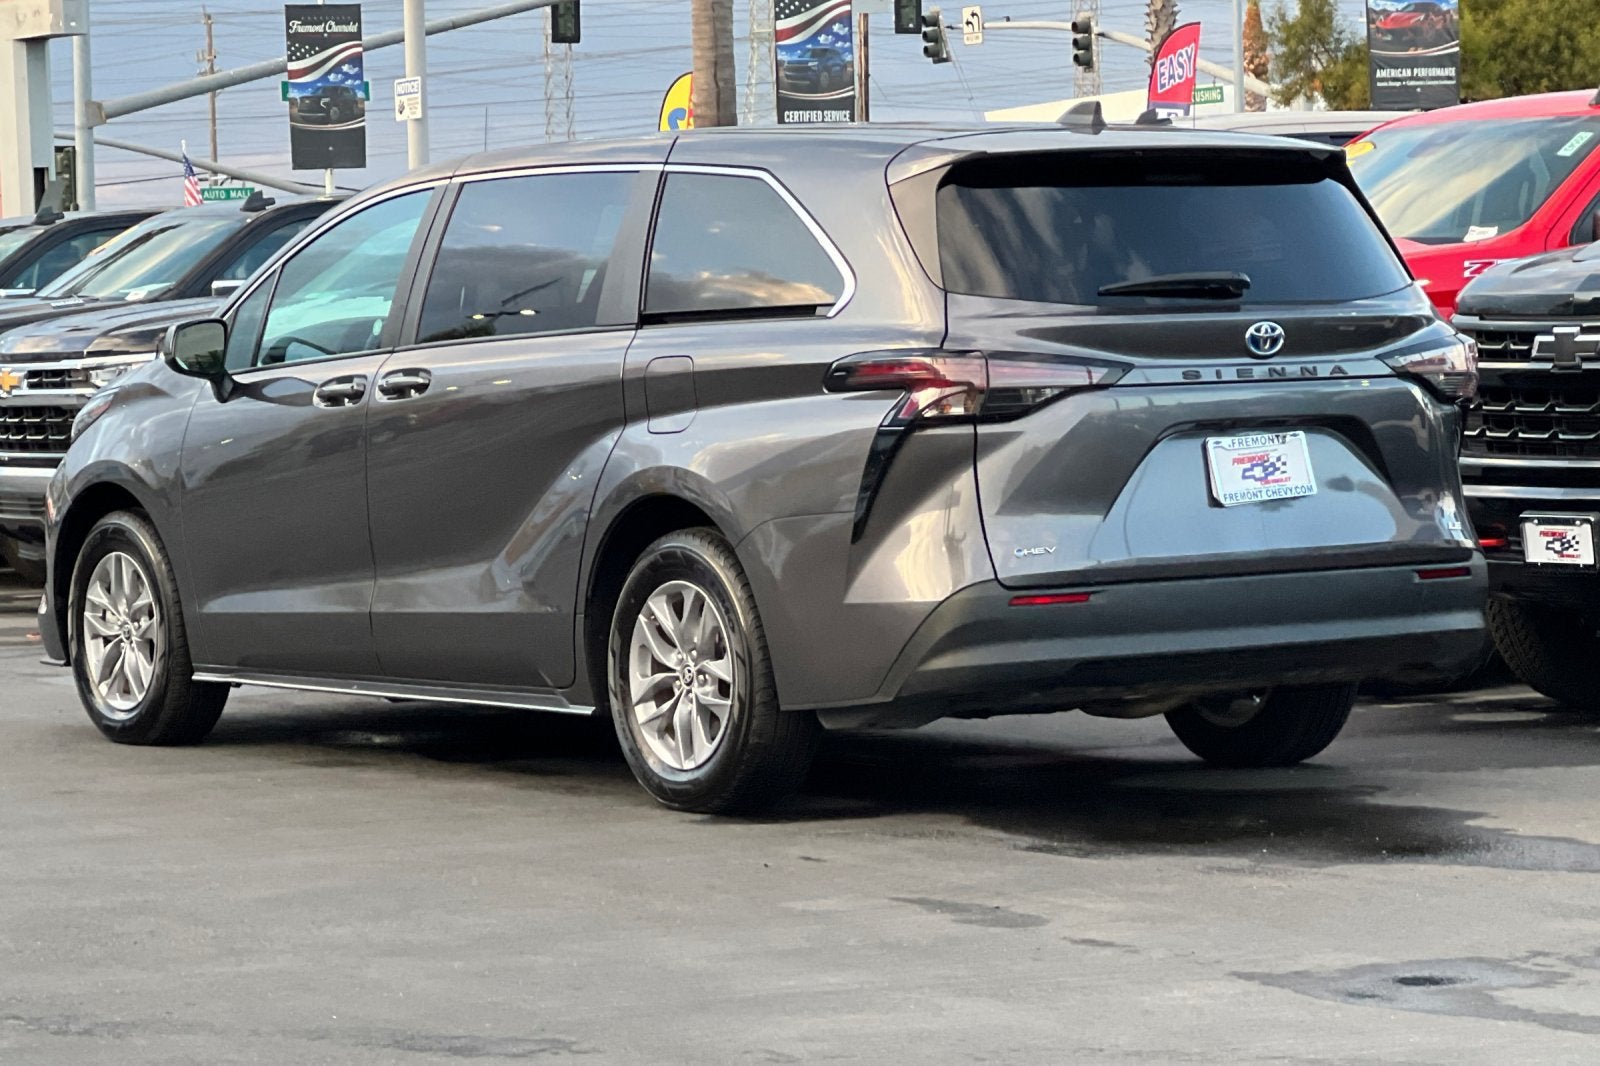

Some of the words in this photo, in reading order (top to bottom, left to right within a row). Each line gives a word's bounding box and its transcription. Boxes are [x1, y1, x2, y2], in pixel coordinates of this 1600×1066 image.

[289, 20, 325, 33] Fremont
[1157, 43, 1195, 94] EASY
[1376, 68, 1412, 78] AMERICAN
[1413, 67, 1456, 77] PERFORMANCE
[396, 80, 420, 95] NOTICE
[784, 110, 822, 122] CERTIFIED
[823, 110, 850, 122] SERVICE
[203, 190, 226, 199] AUTO
[1182, 365, 1348, 380] SIENNA
[1231, 453, 1270, 466] FREMONT
[1223, 490, 1263, 502] FREMONT
[1265, 485, 1314, 498] CHEVY.COM
